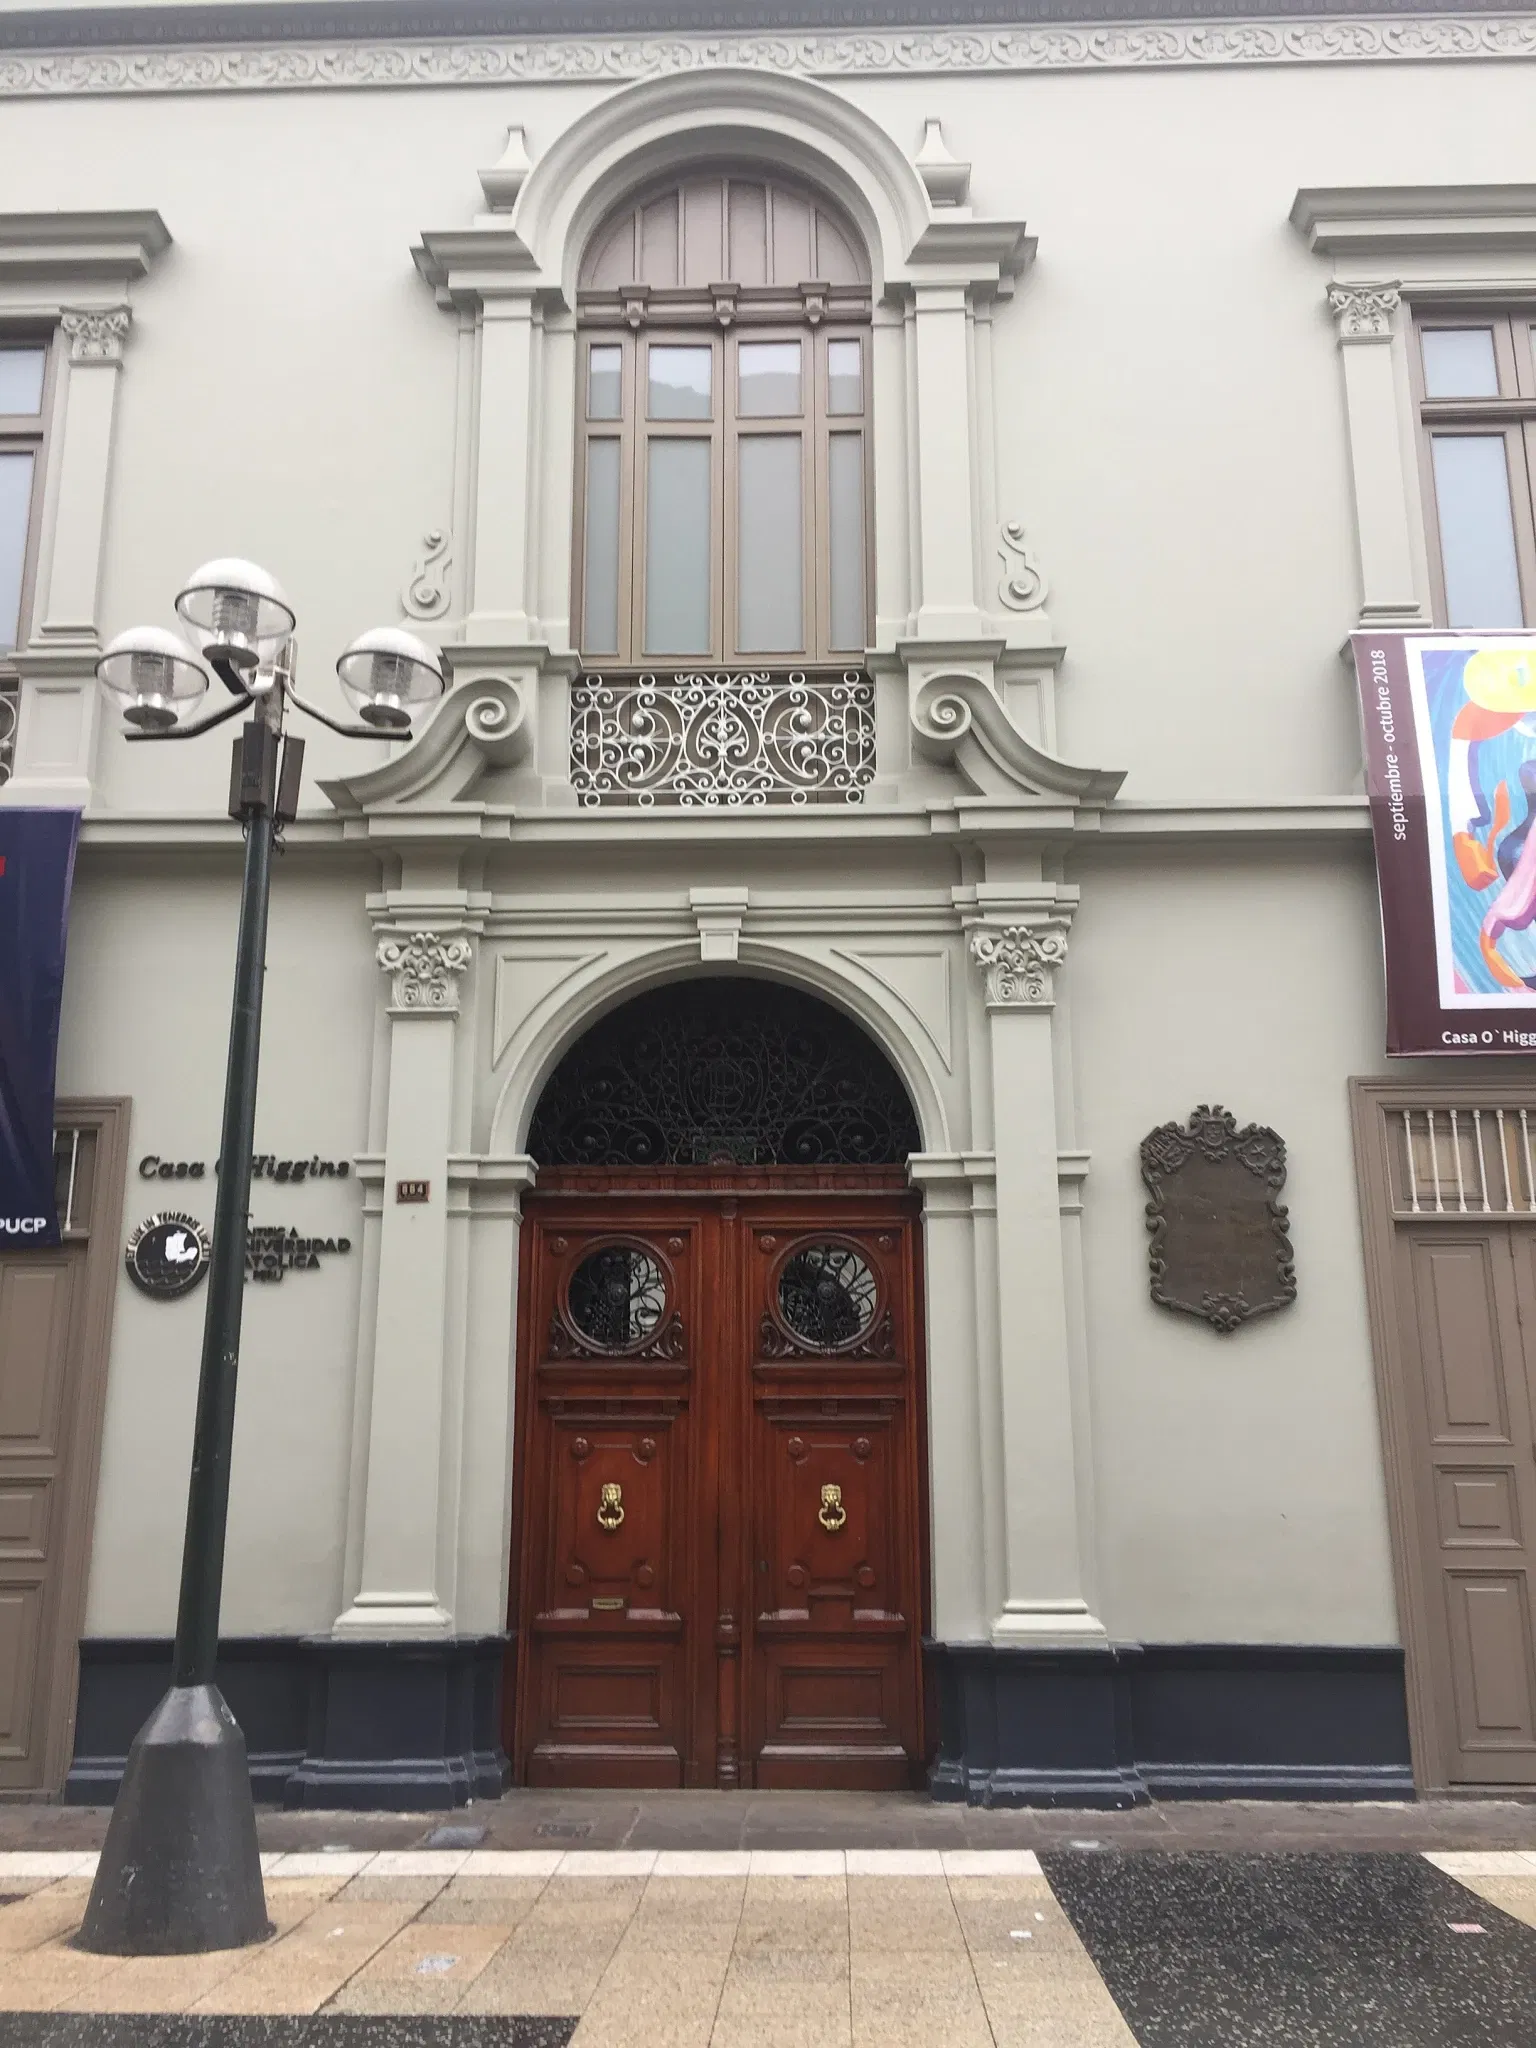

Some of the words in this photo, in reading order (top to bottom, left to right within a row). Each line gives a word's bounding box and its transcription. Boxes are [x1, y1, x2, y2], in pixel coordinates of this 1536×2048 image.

[1370, 650, 1389, 683] 2018
[1376, 686, 1396, 742] octubre
[1384, 754, 1409, 840] septiembre
[1441, 1031, 1478, 1044] Casa
[139, 1156, 205, 1178] Casa
[246, 1237, 351, 1253] NIVERSIDAD
[244, 1254, 321, 1269] ATOLICA
